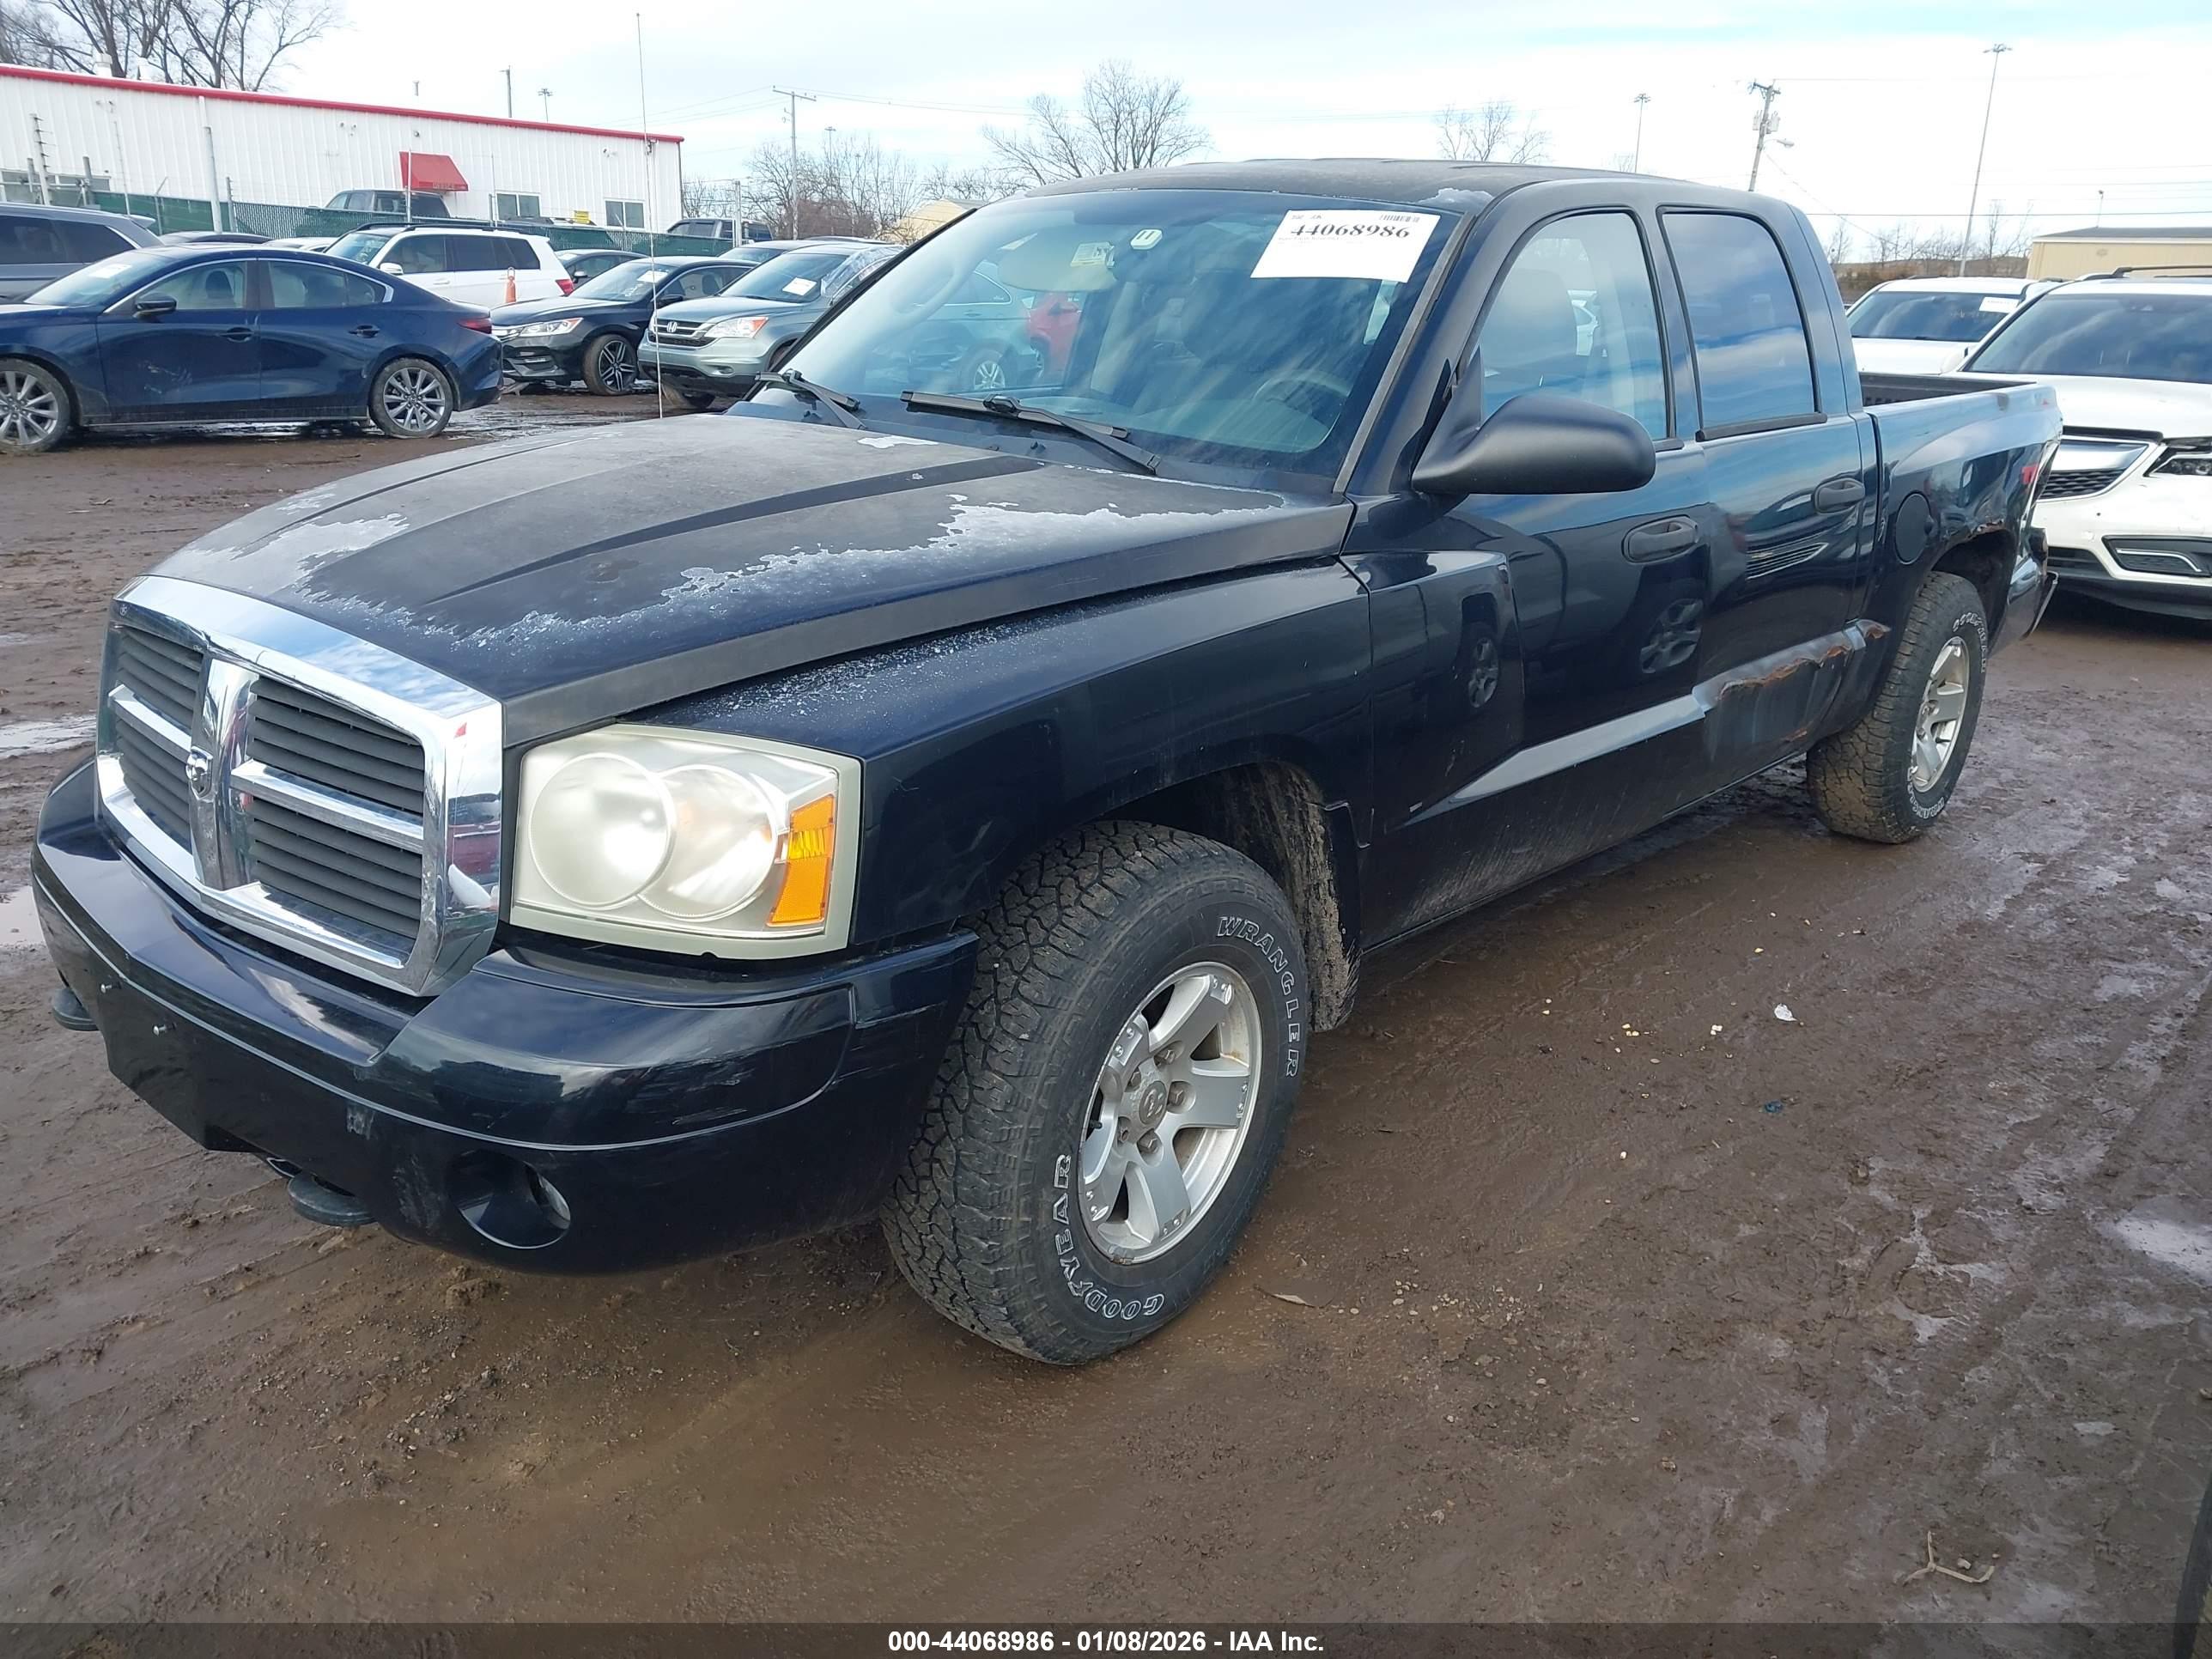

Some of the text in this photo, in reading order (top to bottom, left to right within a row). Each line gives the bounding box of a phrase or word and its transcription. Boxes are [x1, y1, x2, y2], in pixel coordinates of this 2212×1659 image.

[1291, 223, 1410, 239] 44068986
[1217, 916, 1300, 1078] WRANGLER
[1053, 1154, 1164, 1320] GOODYEAR
